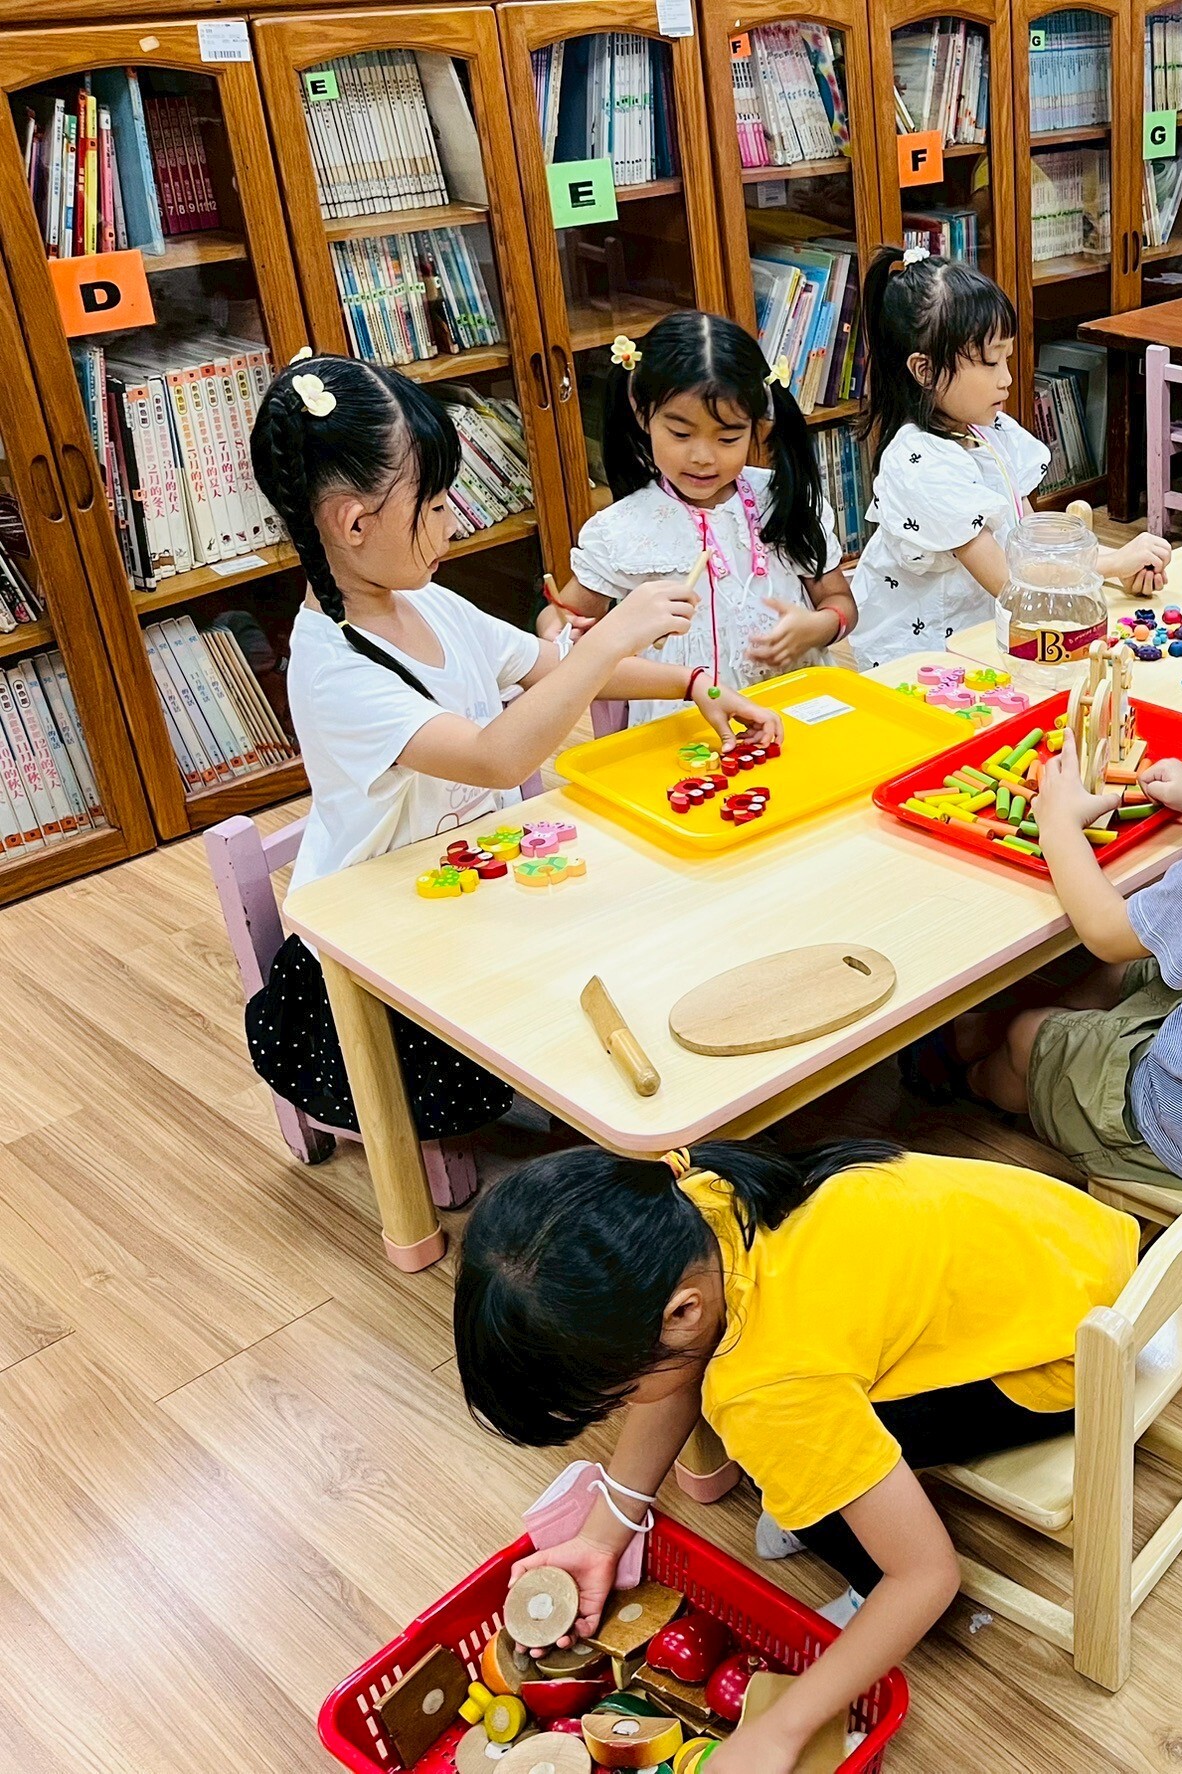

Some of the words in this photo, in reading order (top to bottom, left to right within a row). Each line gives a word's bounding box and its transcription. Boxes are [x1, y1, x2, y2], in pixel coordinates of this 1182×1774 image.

[732, 41, 741, 54] F
[1032, 36, 1041, 46] G
[310, 80, 327, 95] E
[1150, 126, 1166, 145] G
[911, 149, 927, 171] F
[569, 181, 596, 208] E
[178, 205, 186, 215] 8
[188, 203, 196, 212] 9
[80, 282, 121, 313] D
